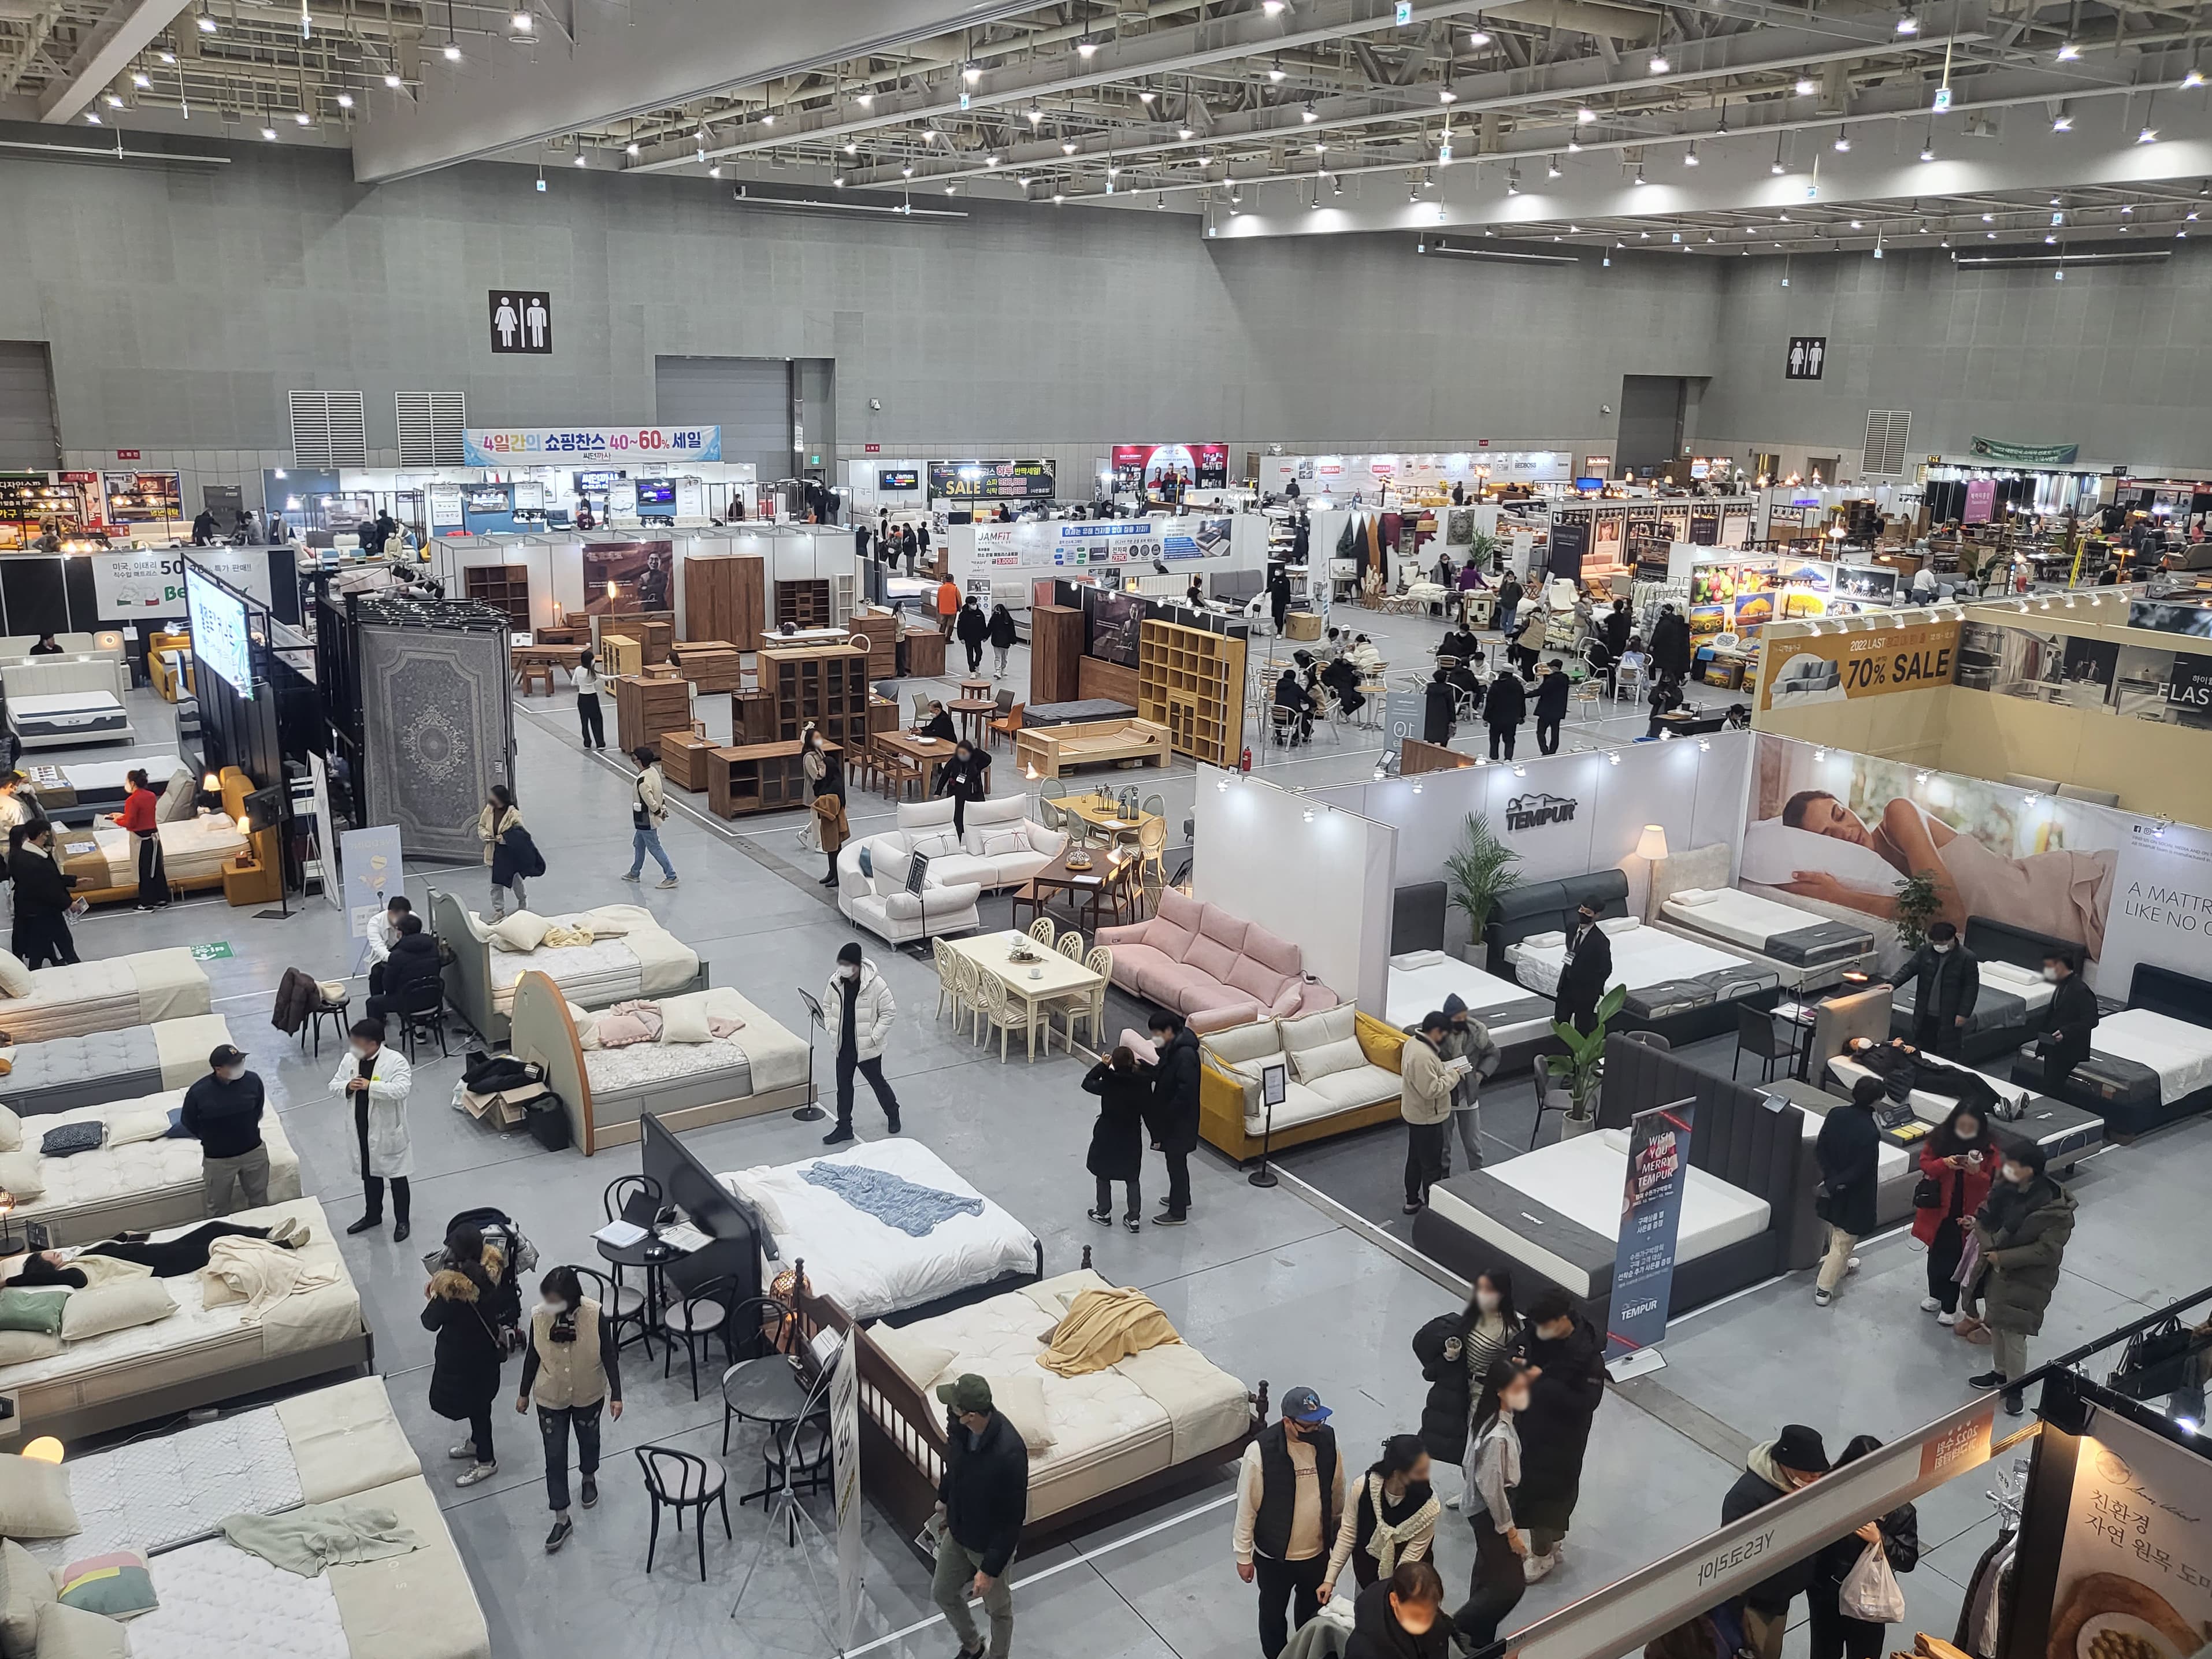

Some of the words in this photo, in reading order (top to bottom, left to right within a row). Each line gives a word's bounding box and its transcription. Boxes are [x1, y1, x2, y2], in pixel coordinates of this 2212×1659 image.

[483, 434, 541, 451] 4일간의
[545, 433, 605, 451] 쇼핑찬스
[672, 432, 701, 449] 세일
[996, 465, 1014, 476] 하루
[1015, 467, 1041, 476] 반짝세일!
[945, 480, 981, 495] SALE
[113, 562, 131, 571] 미국,
[134, 561, 157, 570] 이태리
[214, 563, 230, 573] 특가
[232, 563, 252, 573] 판매!!
[1850, 640, 1866, 651] 2022
[1867, 637, 1886, 650] LAST
[1847, 658, 1886, 689] 70%
[1892, 648, 1950, 682] SALE
[1506, 804, 1575, 830] TEMPUR
[2128, 882, 2141, 897] A
[2125, 900, 2161, 922] LIKE
[2167, 911, 2196, 931] NO
[1649, 1131, 1675, 1147] WISH
[1650, 1145, 1668, 1159] YOU
[1642, 1156, 1672, 1175] MERRY
[1638, 1167, 1673, 1187] TEMPUR
[1621, 1300, 1658, 1321] TEMPUR
[2089, 1489, 2150, 1535] 친환경
[2085, 1513, 2125, 1548] 자연
[2132, 1538, 2173, 1573] 원목
